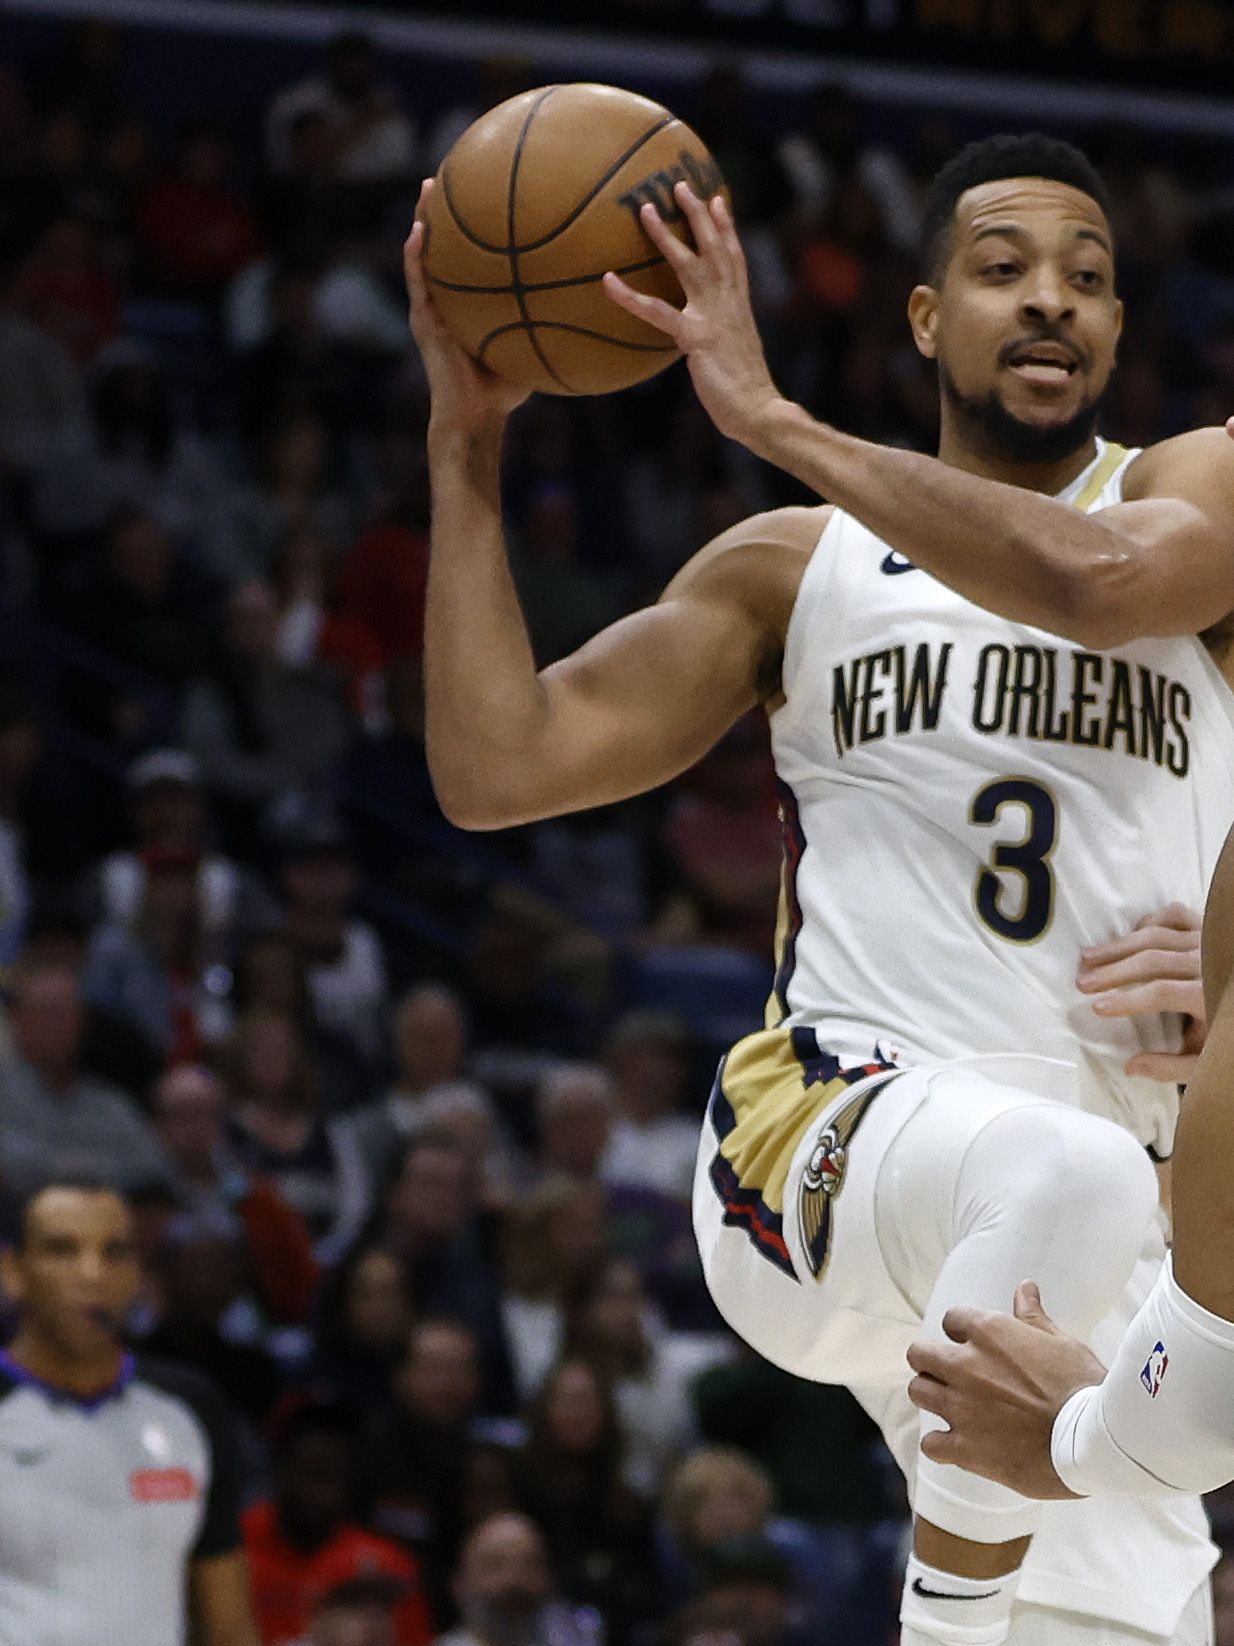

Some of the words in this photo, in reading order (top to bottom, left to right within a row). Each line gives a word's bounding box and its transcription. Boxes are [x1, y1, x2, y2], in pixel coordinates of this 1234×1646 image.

[831, 642, 953, 759] NEW
[971, 643, 1192, 779] ORLEANS
[967, 775, 1061, 946] 3
